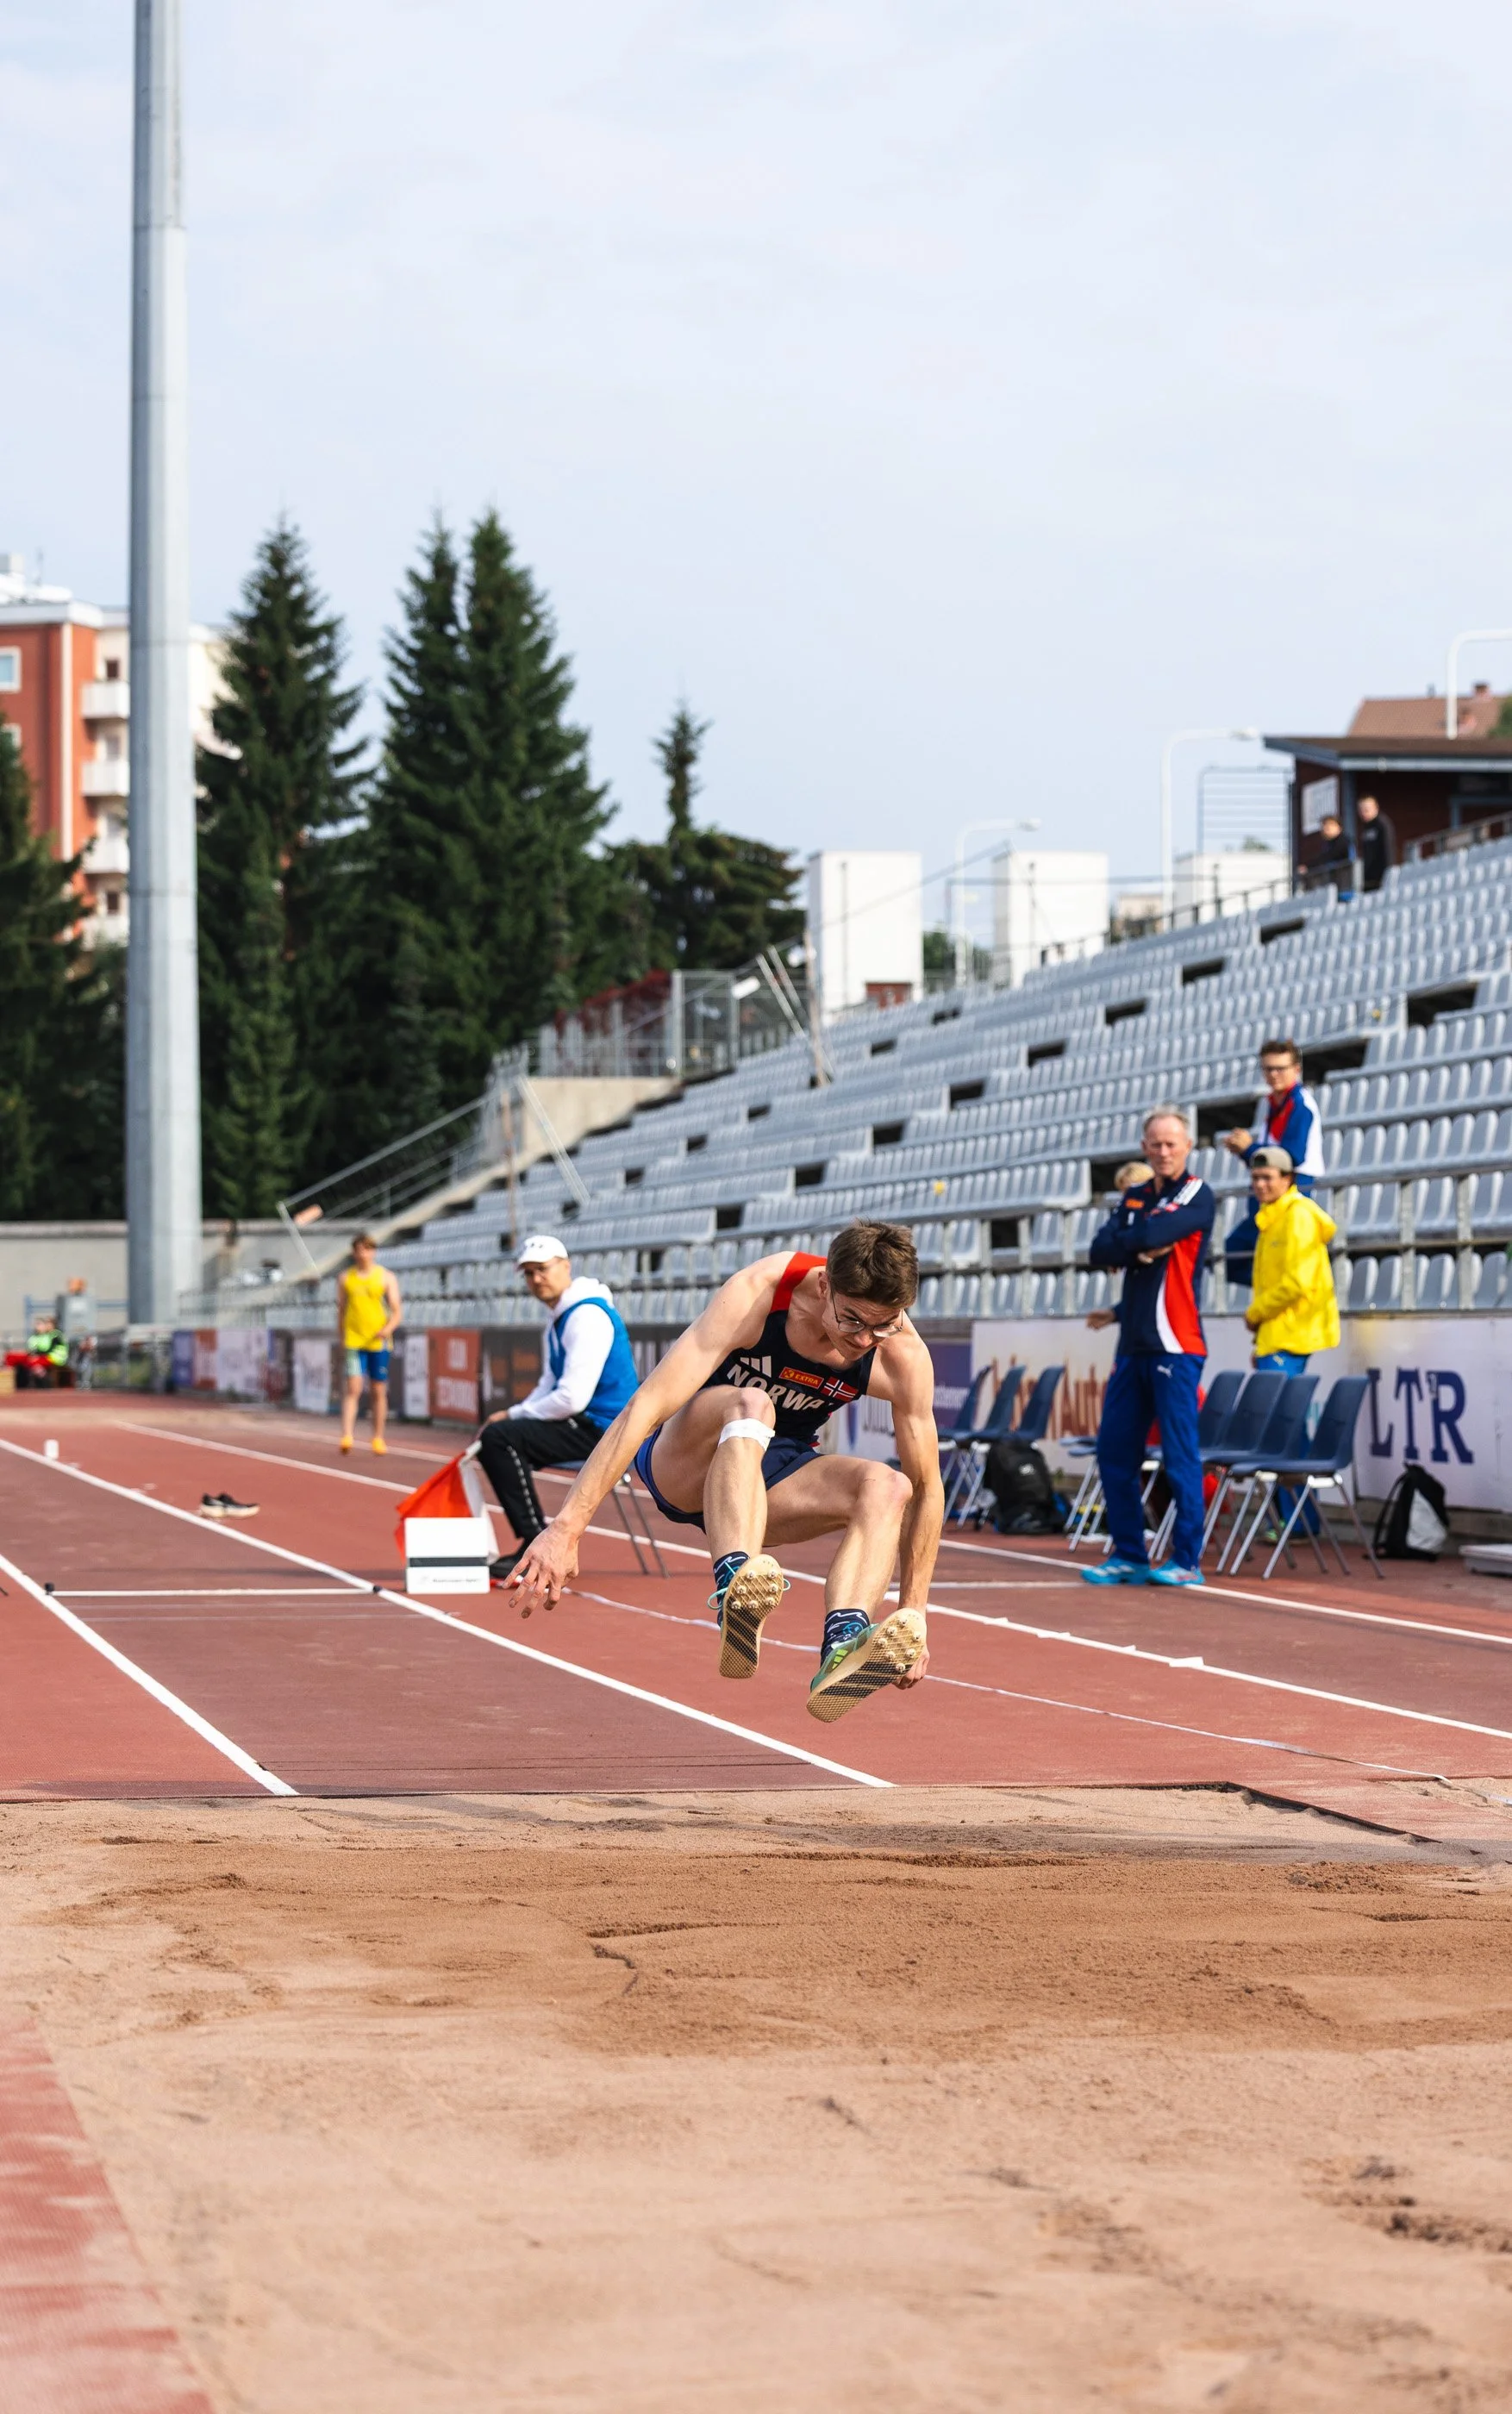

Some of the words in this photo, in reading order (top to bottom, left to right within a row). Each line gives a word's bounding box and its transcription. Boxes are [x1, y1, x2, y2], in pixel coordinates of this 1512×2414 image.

[727, 1364, 834, 1410] NORWA
[795, 1373, 818, 1385] EXTRA
[1366, 1366, 1474, 1464] LTR
